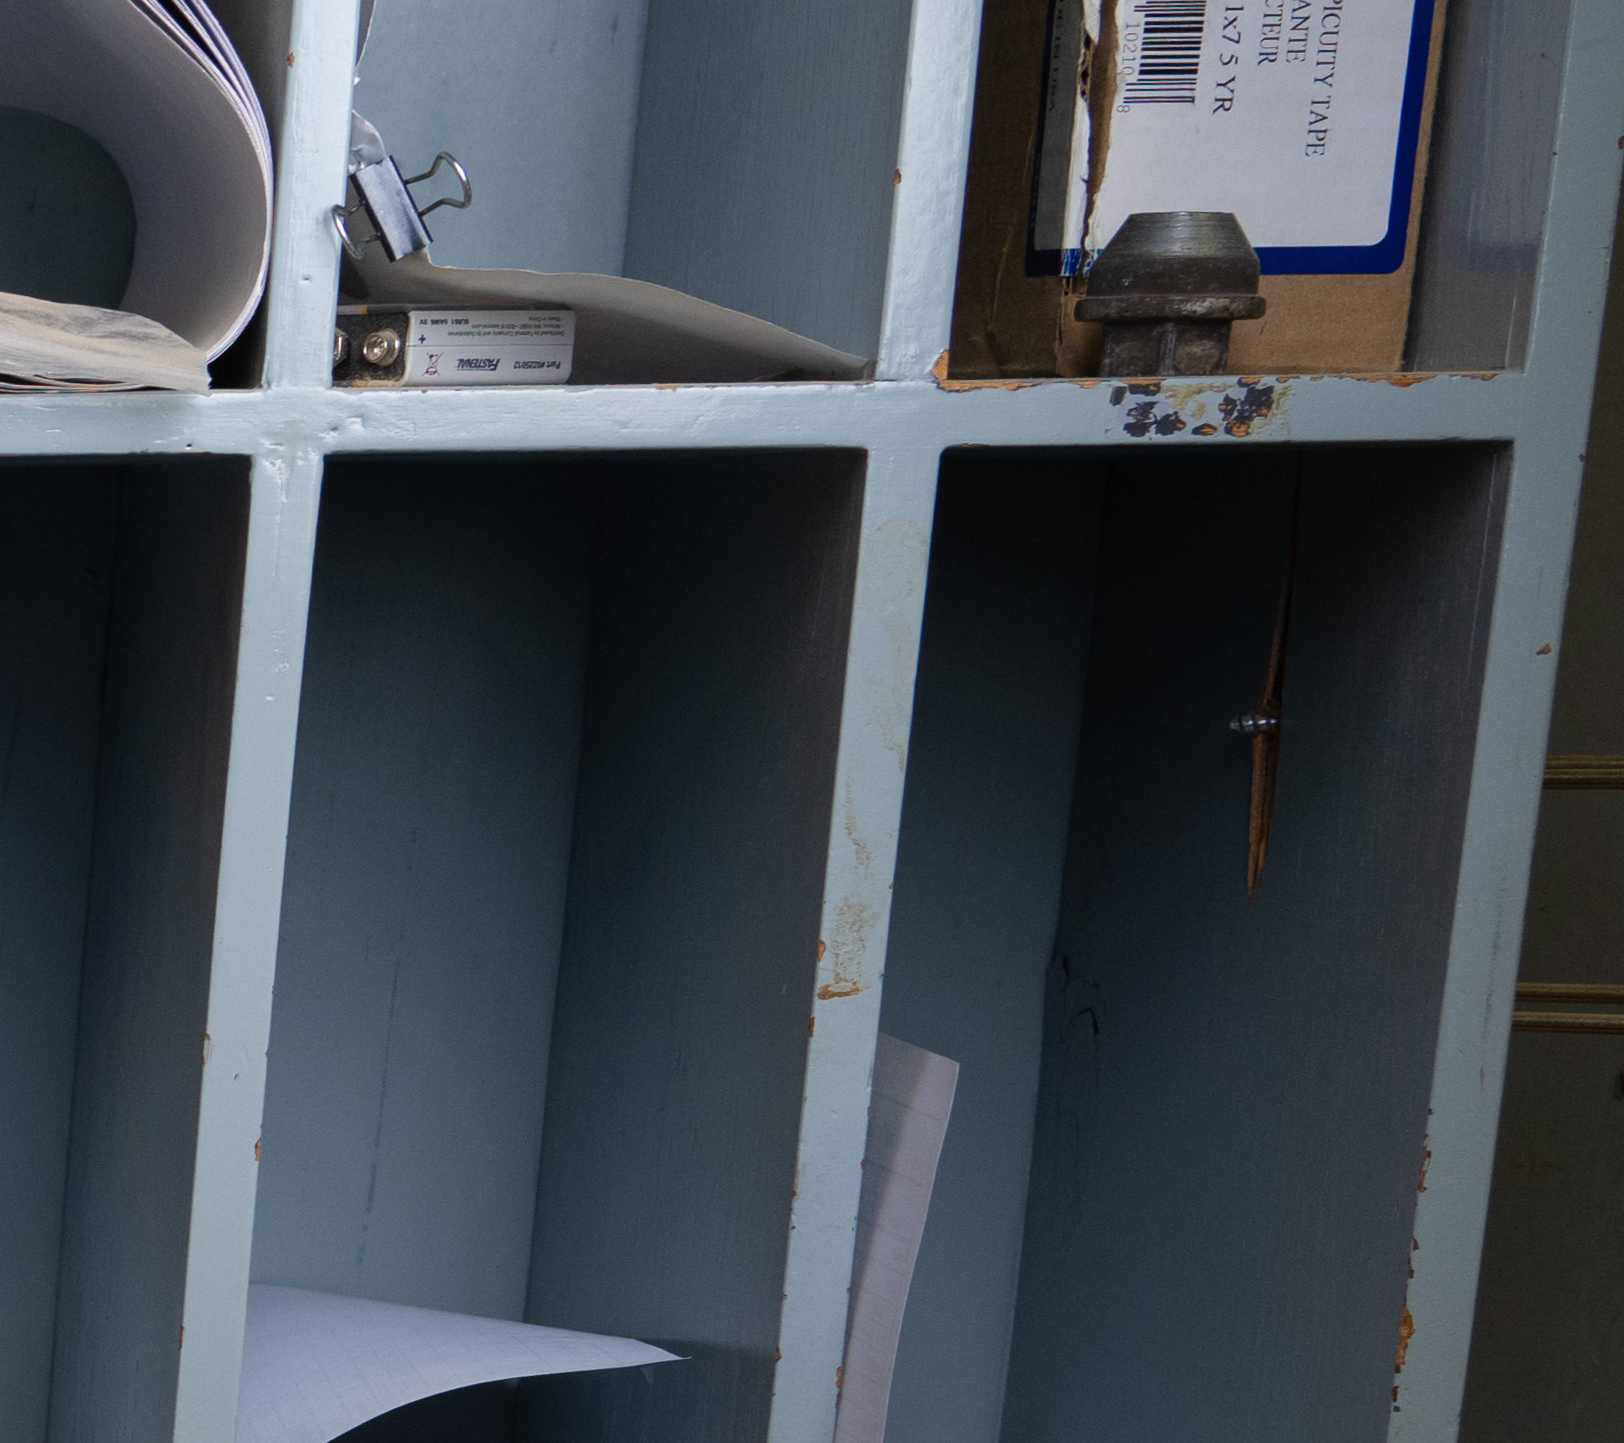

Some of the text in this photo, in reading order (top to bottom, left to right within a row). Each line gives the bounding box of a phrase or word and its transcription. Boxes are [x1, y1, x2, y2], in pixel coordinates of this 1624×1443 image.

[1116, 22, 1140, 113] 10210 8
[1212, 5, 1244, 115] 1x7 5 YR
[1305, 95, 1331, 157] TAPE
[456, 358, 501, 371] FASTENAL
[547, 361, 561, 369] Part
